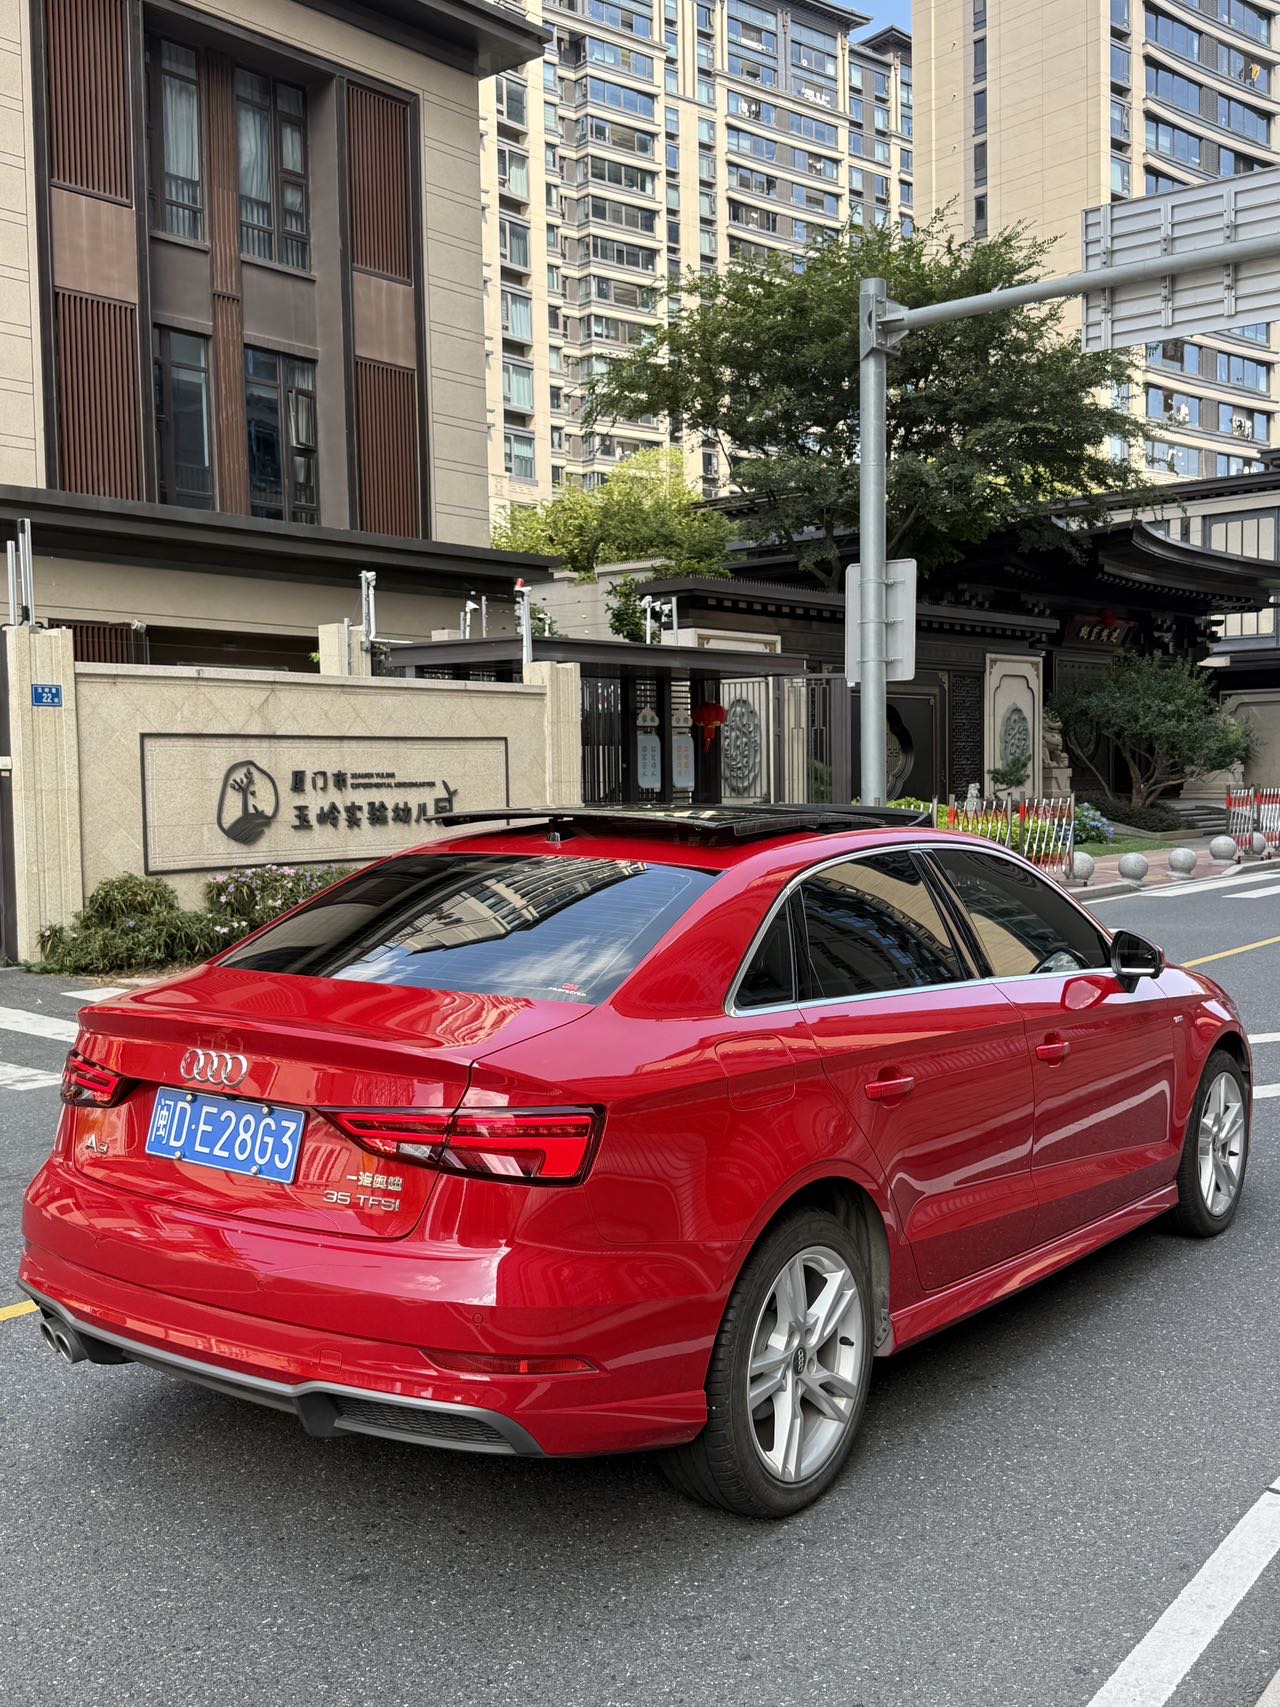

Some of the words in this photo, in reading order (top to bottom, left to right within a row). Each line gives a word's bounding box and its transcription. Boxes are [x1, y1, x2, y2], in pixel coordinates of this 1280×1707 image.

[42, 693, 52, 702] 22
[290, 770, 348, 793] 厦门市
[323, 1190, 351, 1205] 35
[356, 1194, 400, 1212] TFSI
